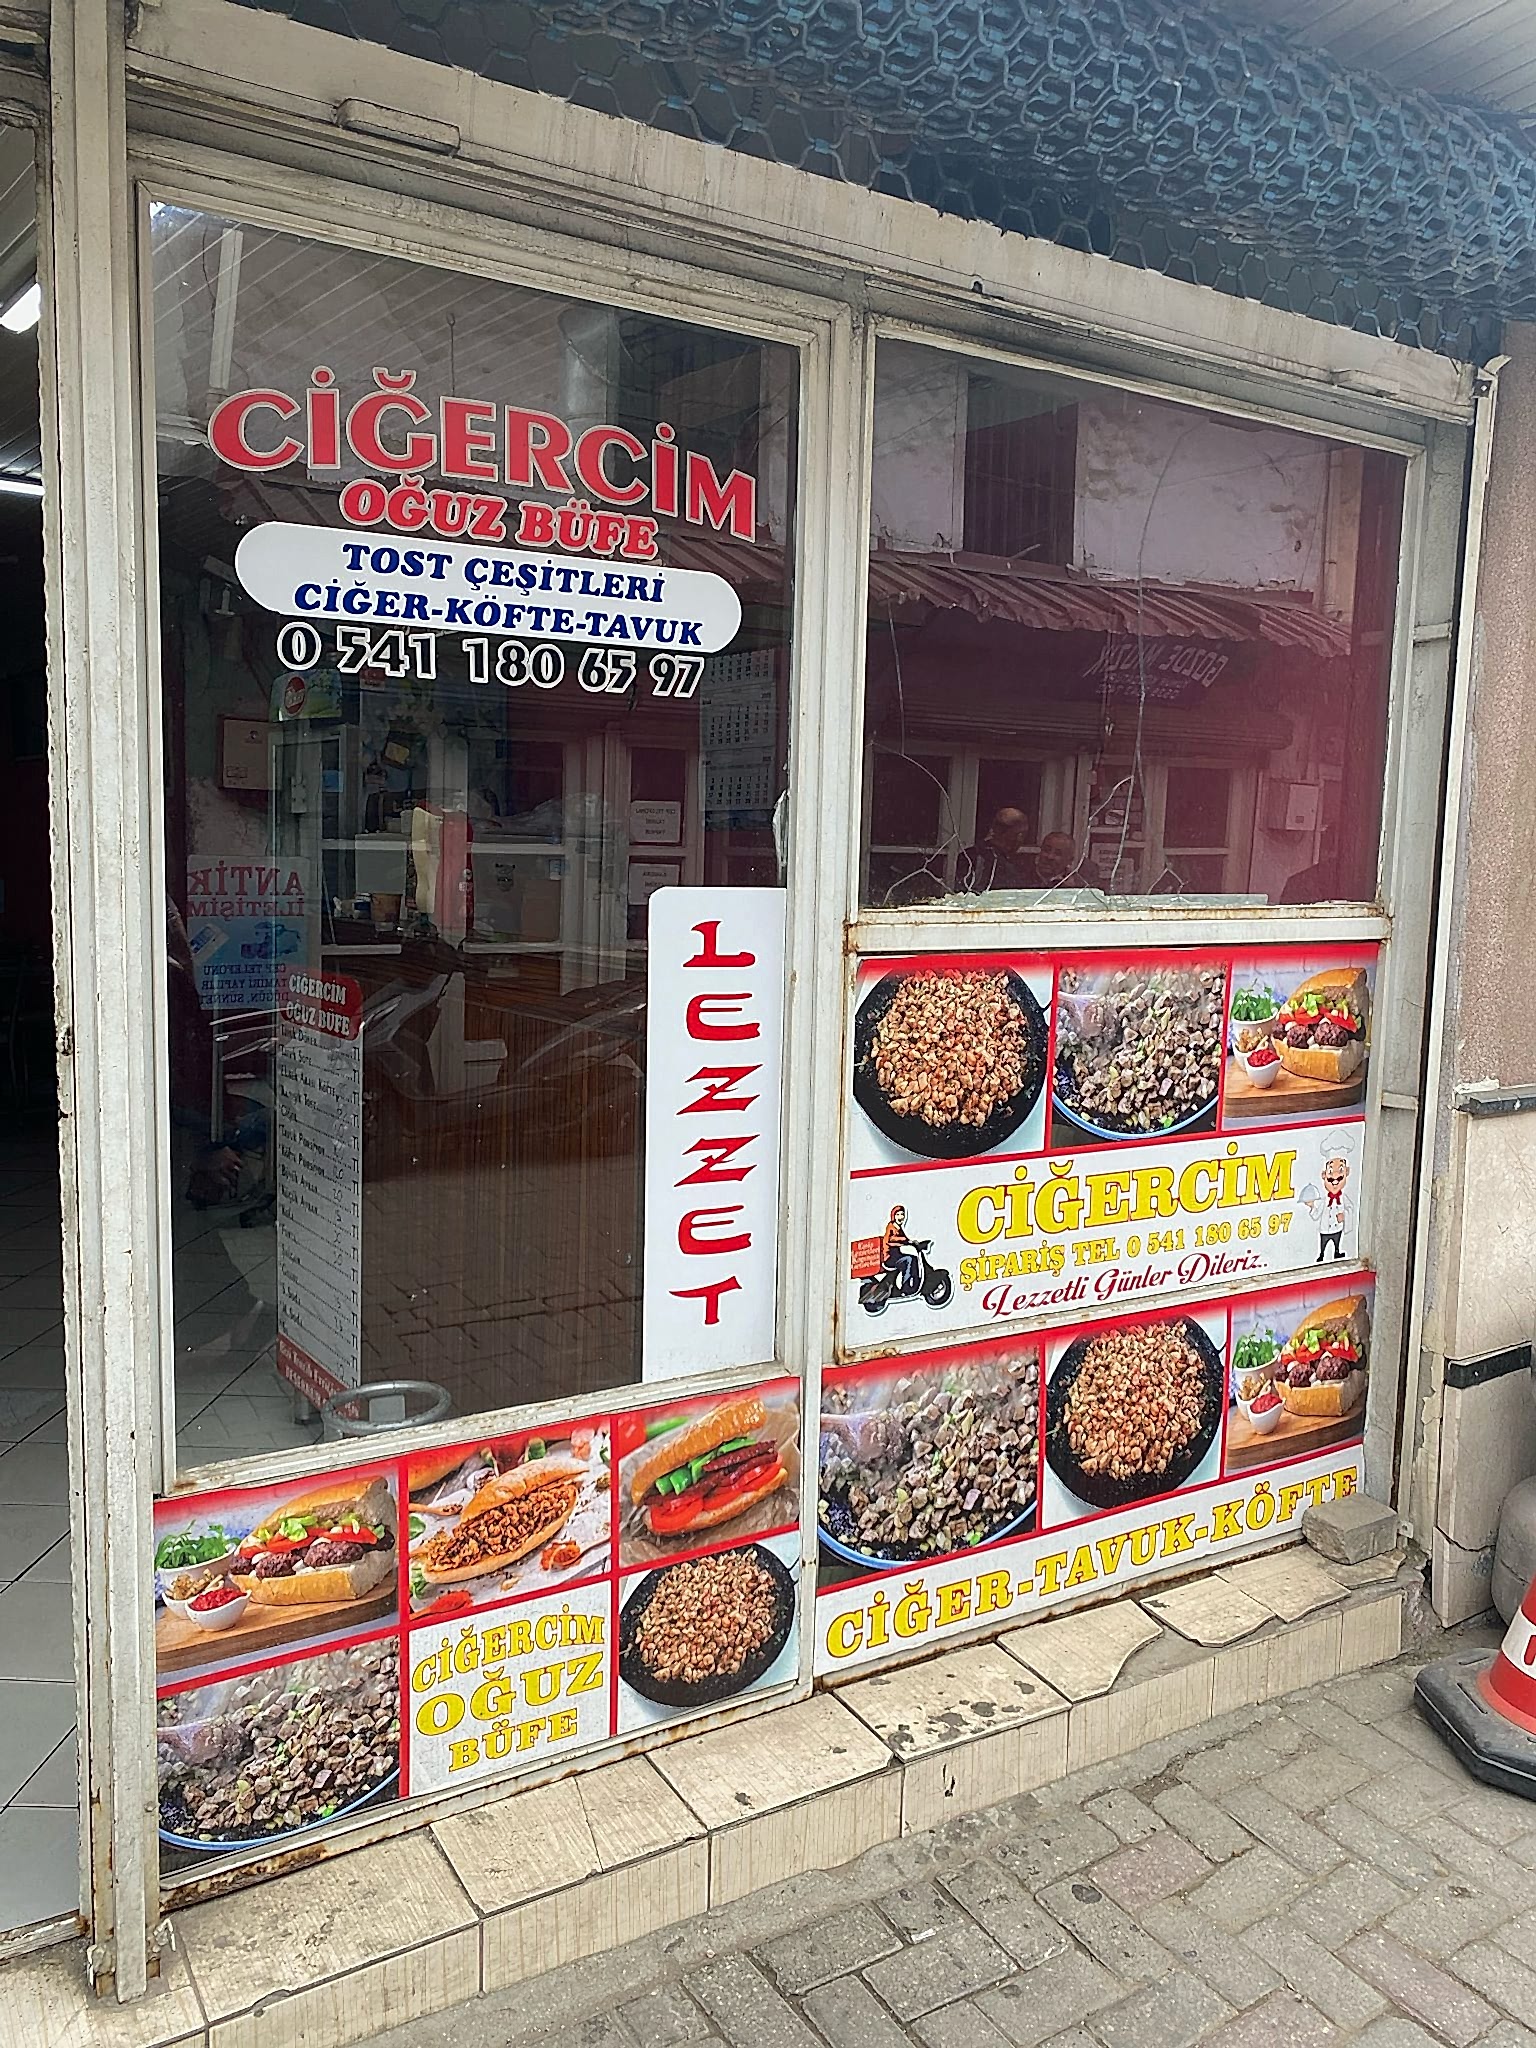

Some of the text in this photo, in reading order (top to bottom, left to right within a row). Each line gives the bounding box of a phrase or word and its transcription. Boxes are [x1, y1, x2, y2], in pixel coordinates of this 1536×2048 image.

[207, 364, 757, 543] CİĞERCİM
[339, 475, 659, 560] OĞUZ BÜFE
[294, 579, 703, 646] CİĞER-KÖFTE-TAVUK
[342, 543, 667, 603] TOST ÇEŞİTLERİ
[277, 622, 321, 671] 0
[336, 624, 436, 680] 541
[462, 639, 565, 690] 180
[577, 648, 637, 693] 65
[650, 655, 705, 699] 97
[288, 971, 346, 1006] CİĞERCİM
[318, 1009, 350, 1038] BÜFE
[668, 920, 763, 1325] LEZZET
[957, 1142, 1297, 1246] CİĞERCİM
[960, 1212, 1294, 1291] ŞİPARİŞ TEL 0 541 180 65 97
[983, 1276, 1088, 1318] Lezzetli
[1094, 1269, 1173, 1306] Günler
[826, 1466, 1358, 1660] CİĞER-TAVUK-KÖFTE
[412, 1603, 605, 1693] CİĞERCİM
[416, 1651, 604, 1736] OĞUZ
[448, 1708, 578, 1772] BÜFE
